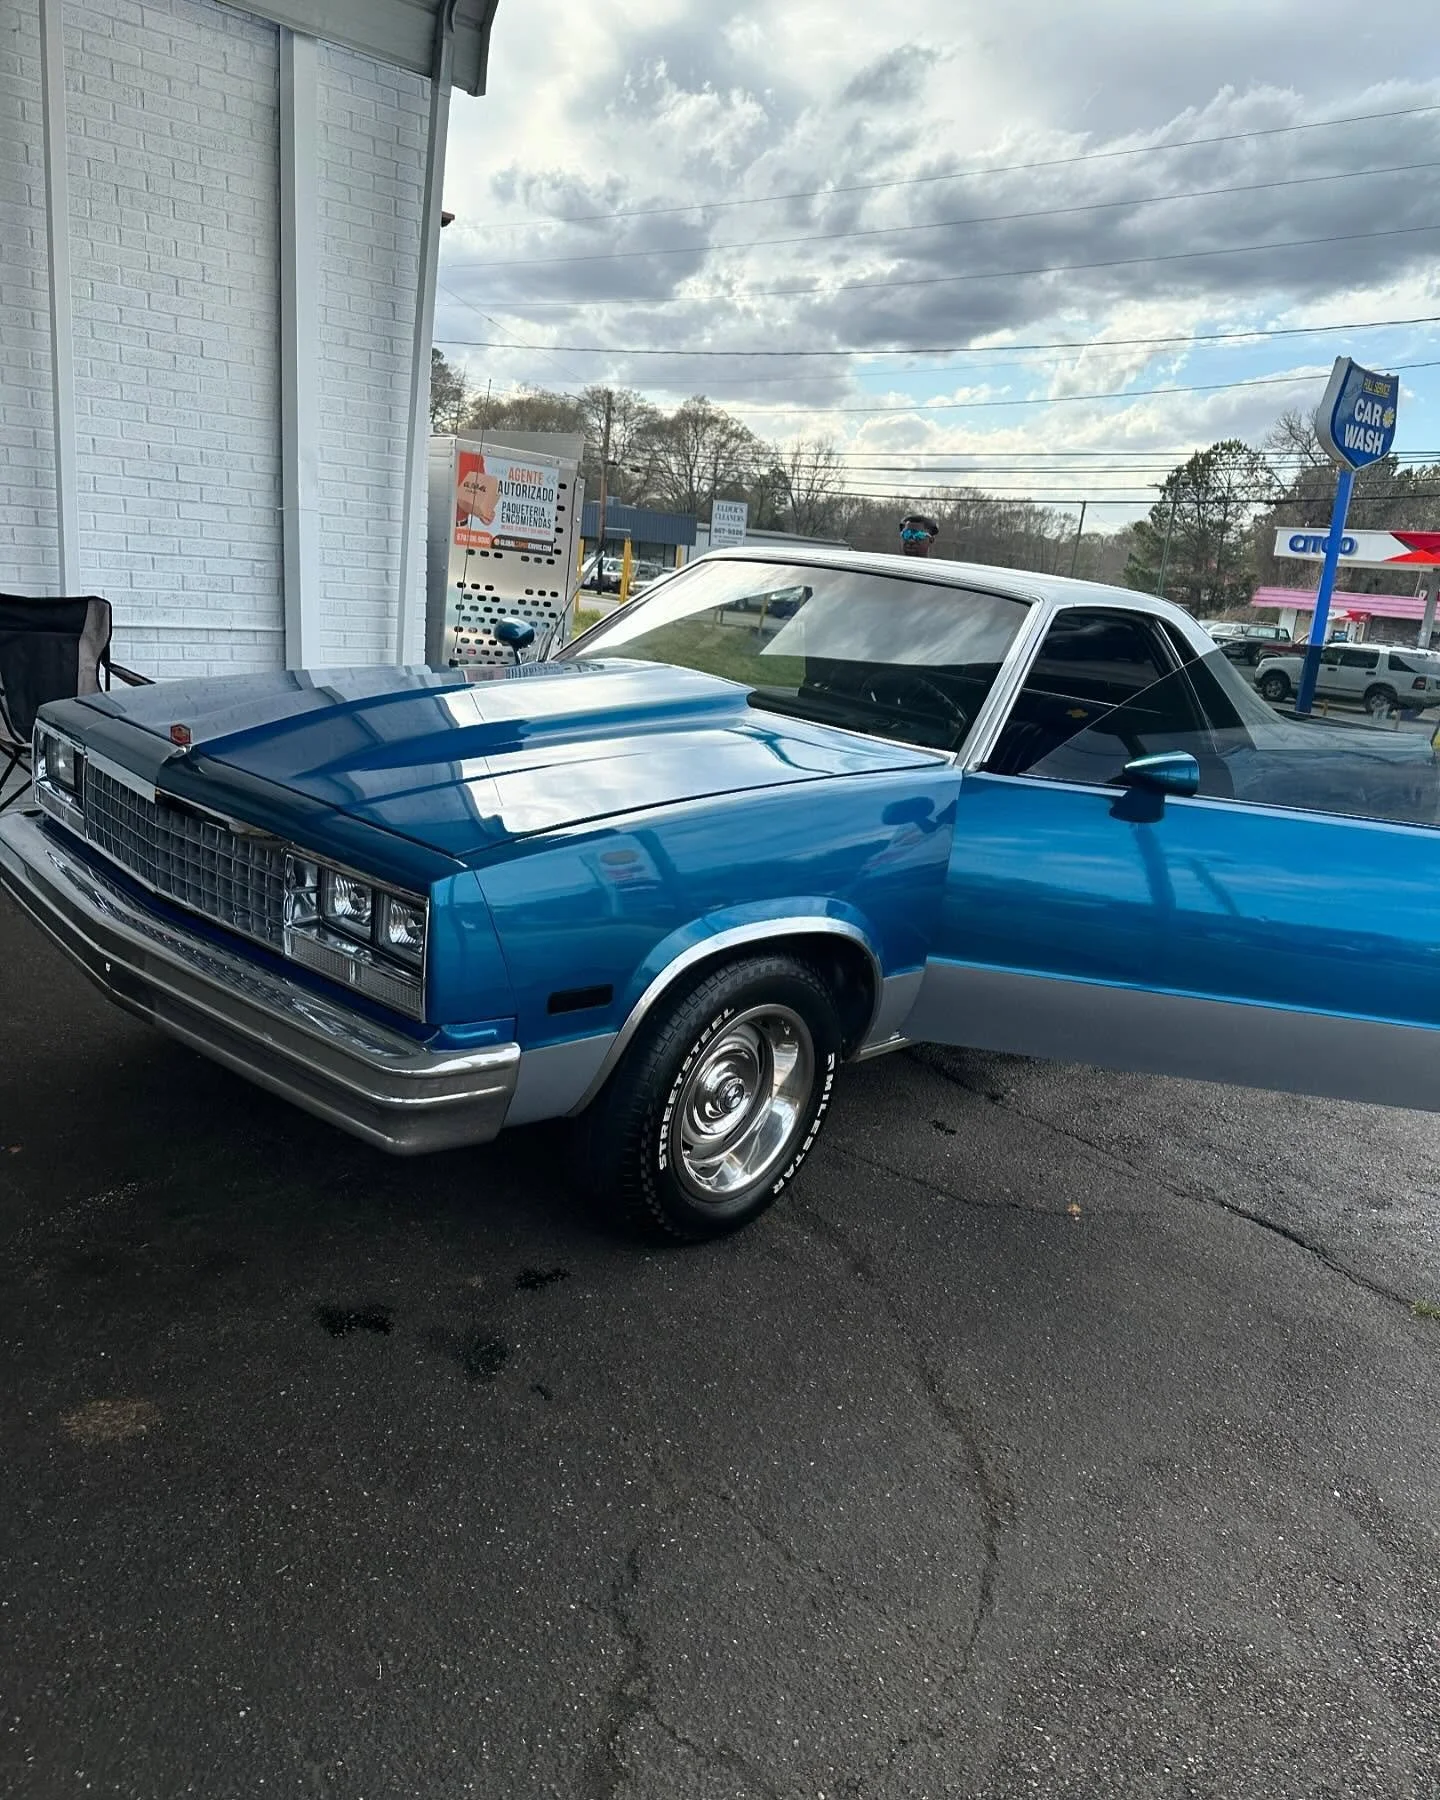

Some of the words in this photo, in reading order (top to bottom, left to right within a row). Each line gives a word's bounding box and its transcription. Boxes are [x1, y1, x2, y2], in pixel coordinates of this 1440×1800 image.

[1354, 398, 1382, 427] CAR
[1344, 424, 1384, 455] WASH
[508, 467, 545, 486] AGENTE
[498, 480, 554, 502] AUTORIZADO
[501, 502, 545, 517] PAQUETERIA
[501, 513, 551, 529] ENCOMIENDAS
[773, 1073, 833, 1194] MILESTAR
